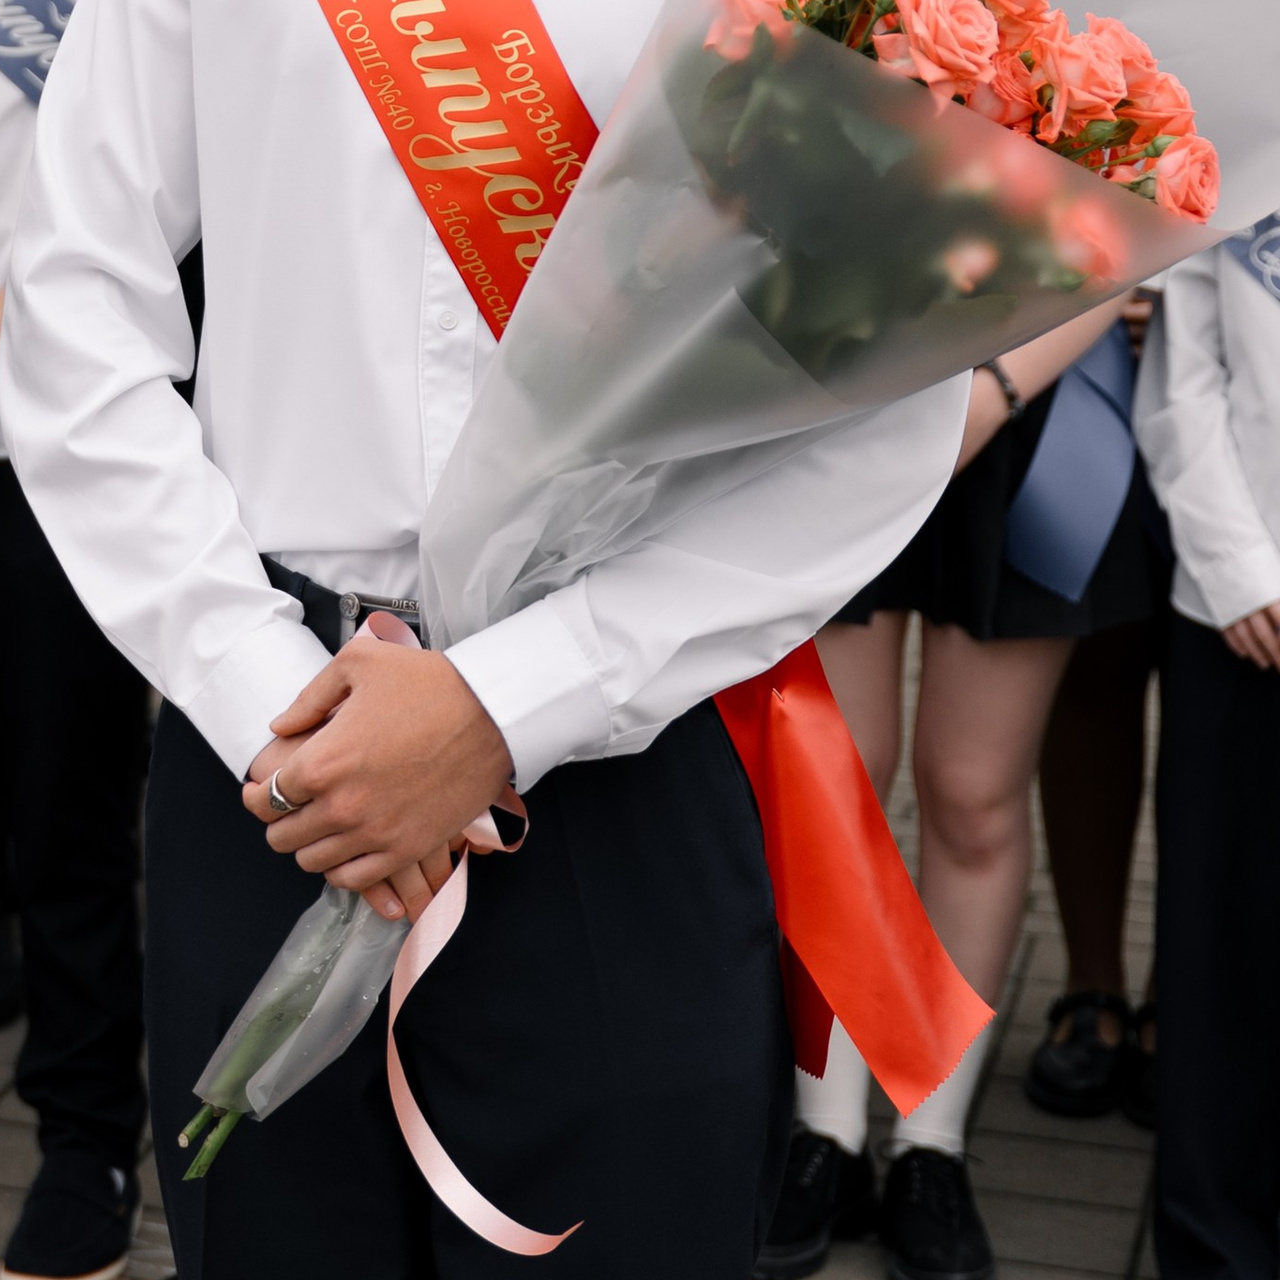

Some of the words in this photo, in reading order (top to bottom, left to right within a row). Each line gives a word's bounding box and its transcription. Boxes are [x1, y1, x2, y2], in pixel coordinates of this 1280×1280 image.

[336, 9, 390, 74] СОШ
[491, 28, 587, 195] Борзык
[436, 200, 513, 329] Новоросси
